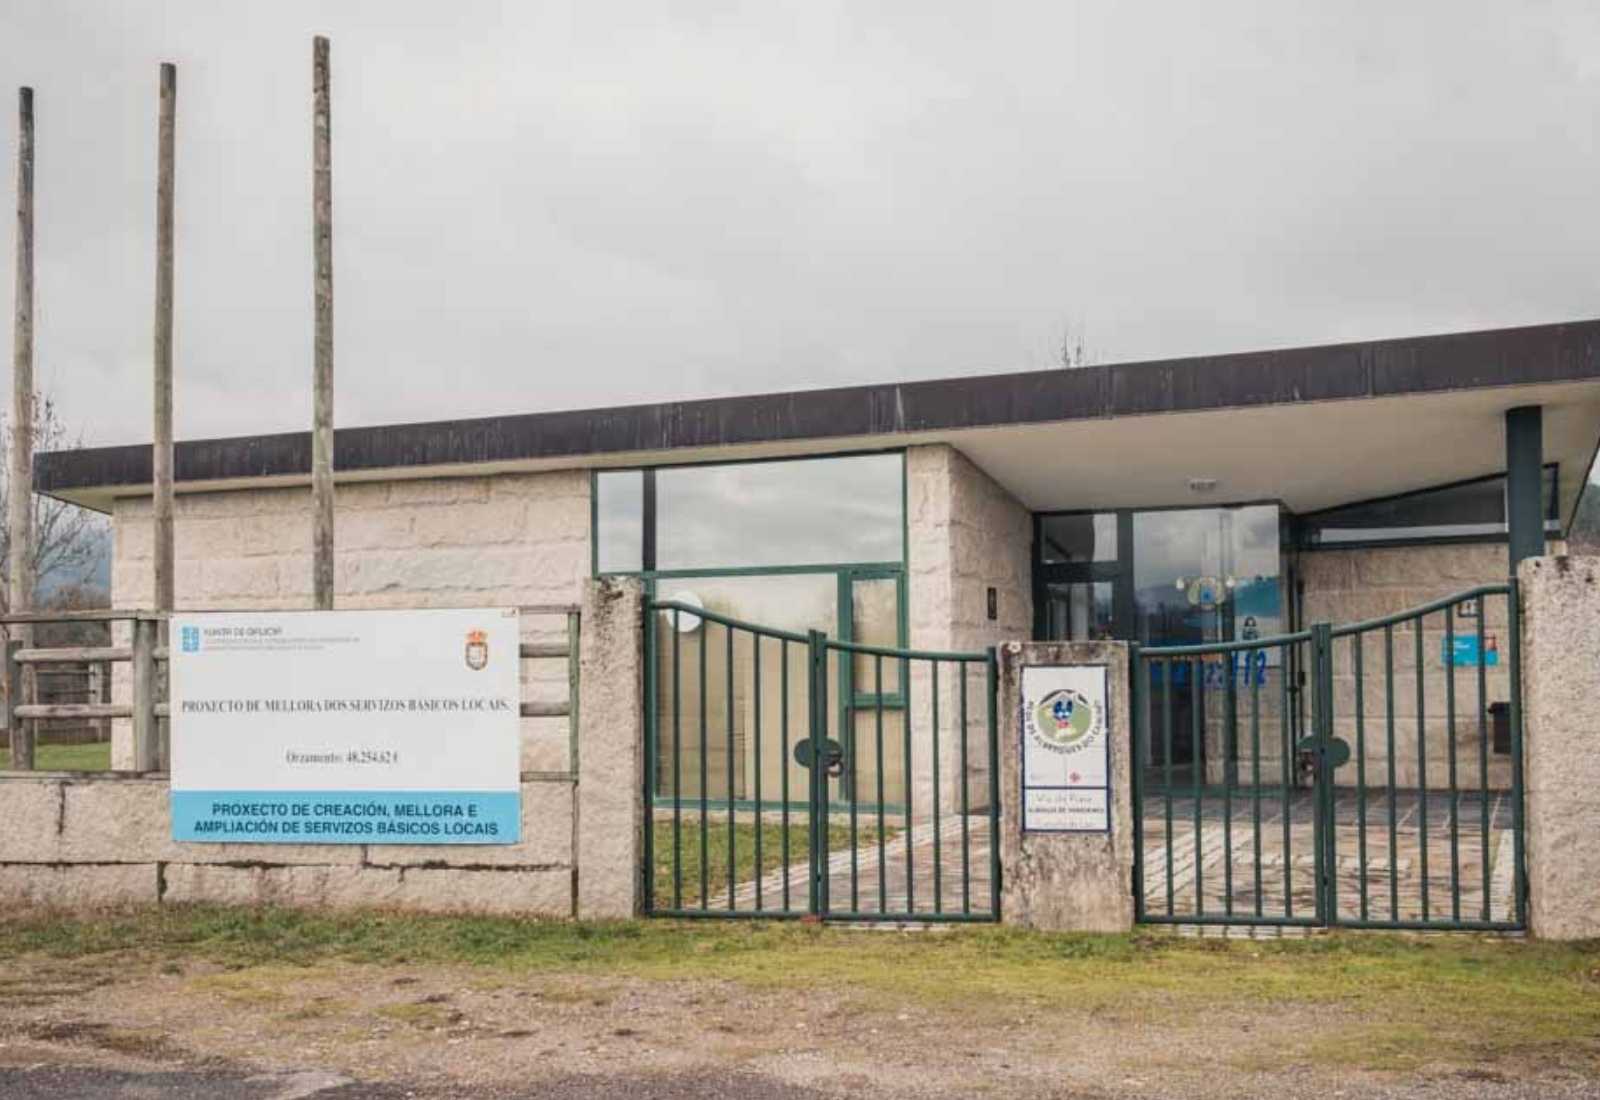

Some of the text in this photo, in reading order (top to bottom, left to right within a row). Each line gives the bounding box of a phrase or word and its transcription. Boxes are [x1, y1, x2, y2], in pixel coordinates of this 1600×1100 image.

[182, 699, 244, 713] PROXECTO
[246, 699, 260, 713] DE
[264, 699, 322, 713] MELLORA
[323, 699, 347, 712] DOS
[349, 699, 406, 712] SERVIZOS
[212, 801, 478, 817] PROXECTO DE CREACIÓN, MELLORA E
[194, 819, 499, 835] AMPLIACIÓN DE SERVIZOS BÁSICOS LOCAIS
